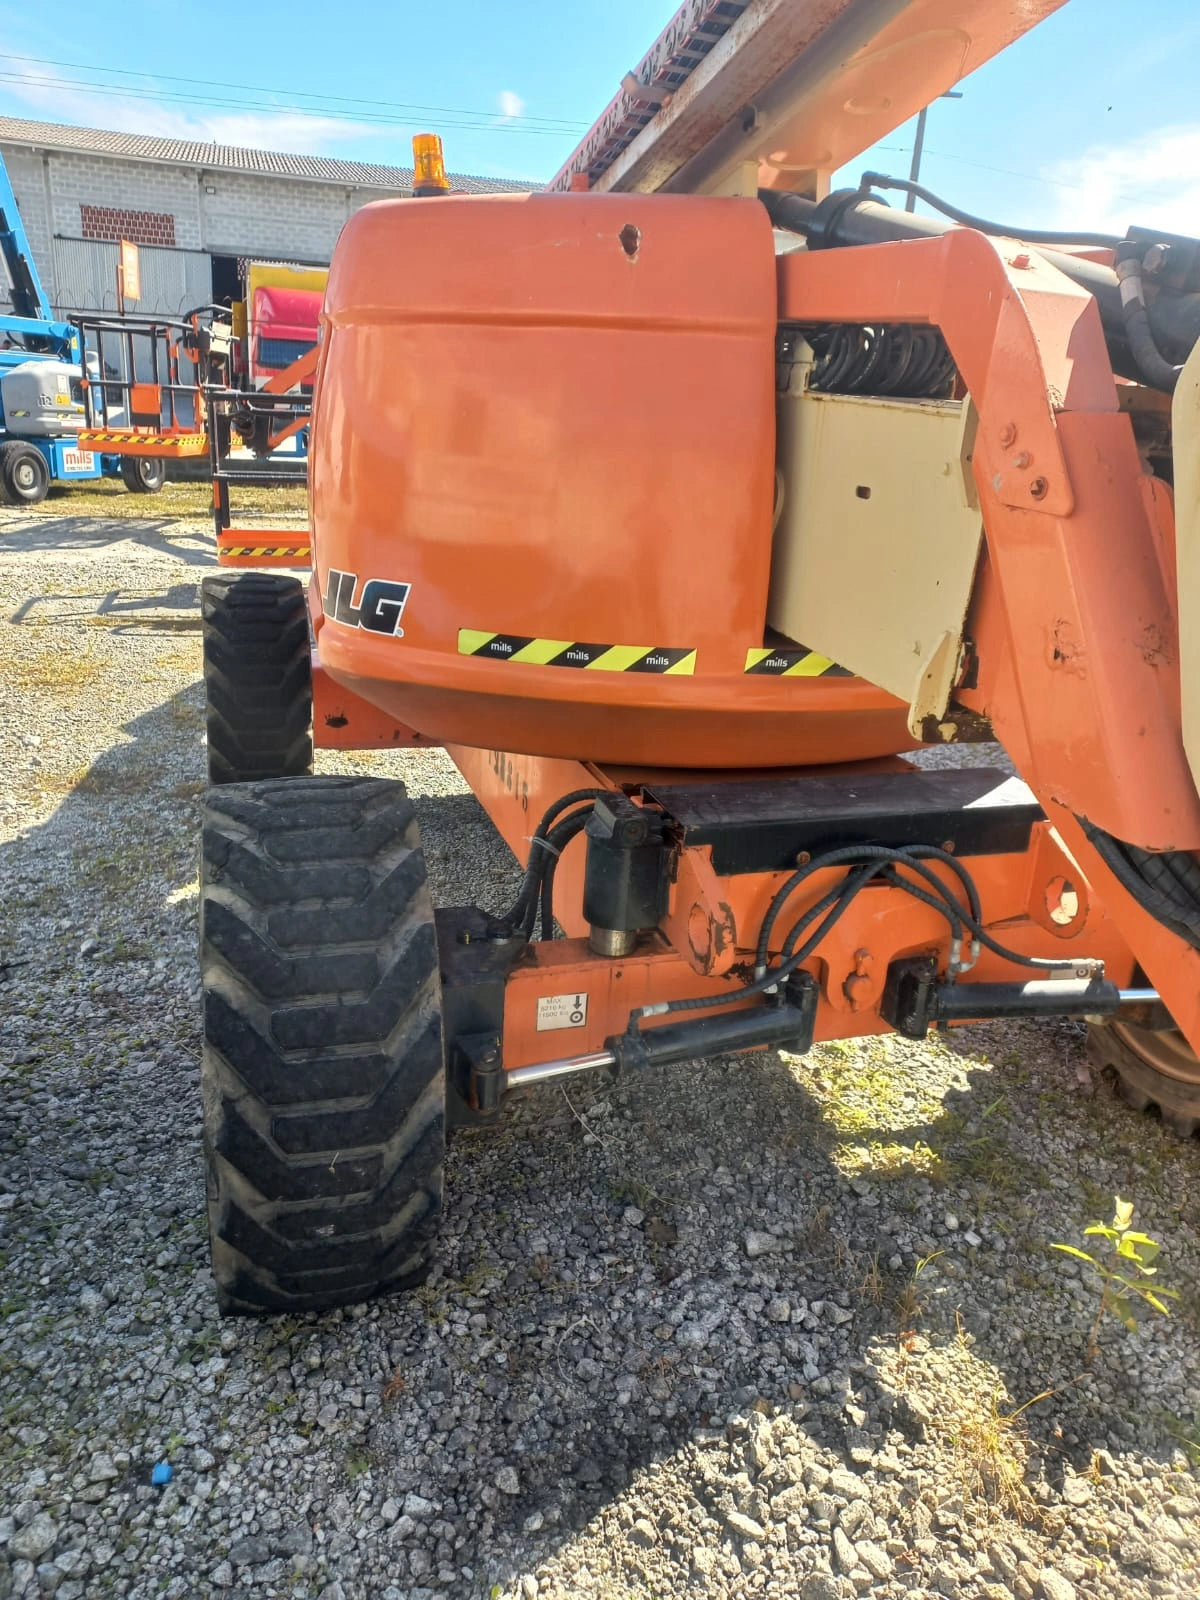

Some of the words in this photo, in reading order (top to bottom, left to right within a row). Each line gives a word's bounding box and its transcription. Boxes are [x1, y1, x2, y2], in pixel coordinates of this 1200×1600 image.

[66, 450, 92, 464] mills
[322, 568, 412, 637] JLG
[490, 641, 512, 653] mills
[566, 649, 590, 661] mills
[645, 655, 669, 666] mills
[765, 657, 788, 667] mills
